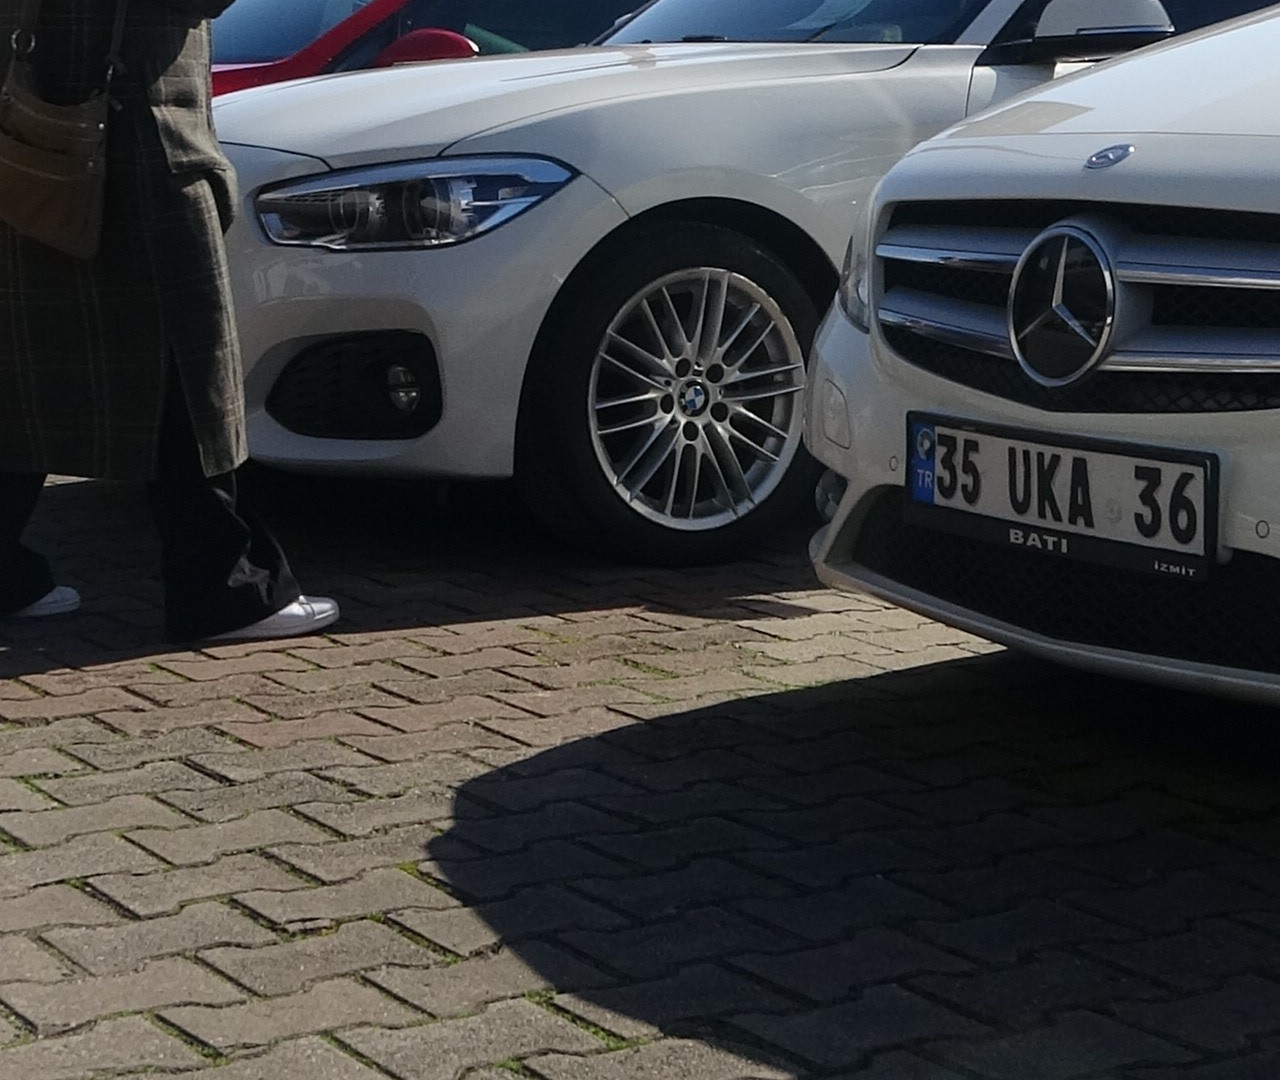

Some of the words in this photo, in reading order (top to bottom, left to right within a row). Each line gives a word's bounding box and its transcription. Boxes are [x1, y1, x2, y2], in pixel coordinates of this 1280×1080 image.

[917, 469, 934, 489] TR
[936, 433, 981, 507] 35
[1007, 445, 1096, 529] UKA
[1133, 464, 1198, 546] 36
[1008, 527, 1069, 554] BATI
